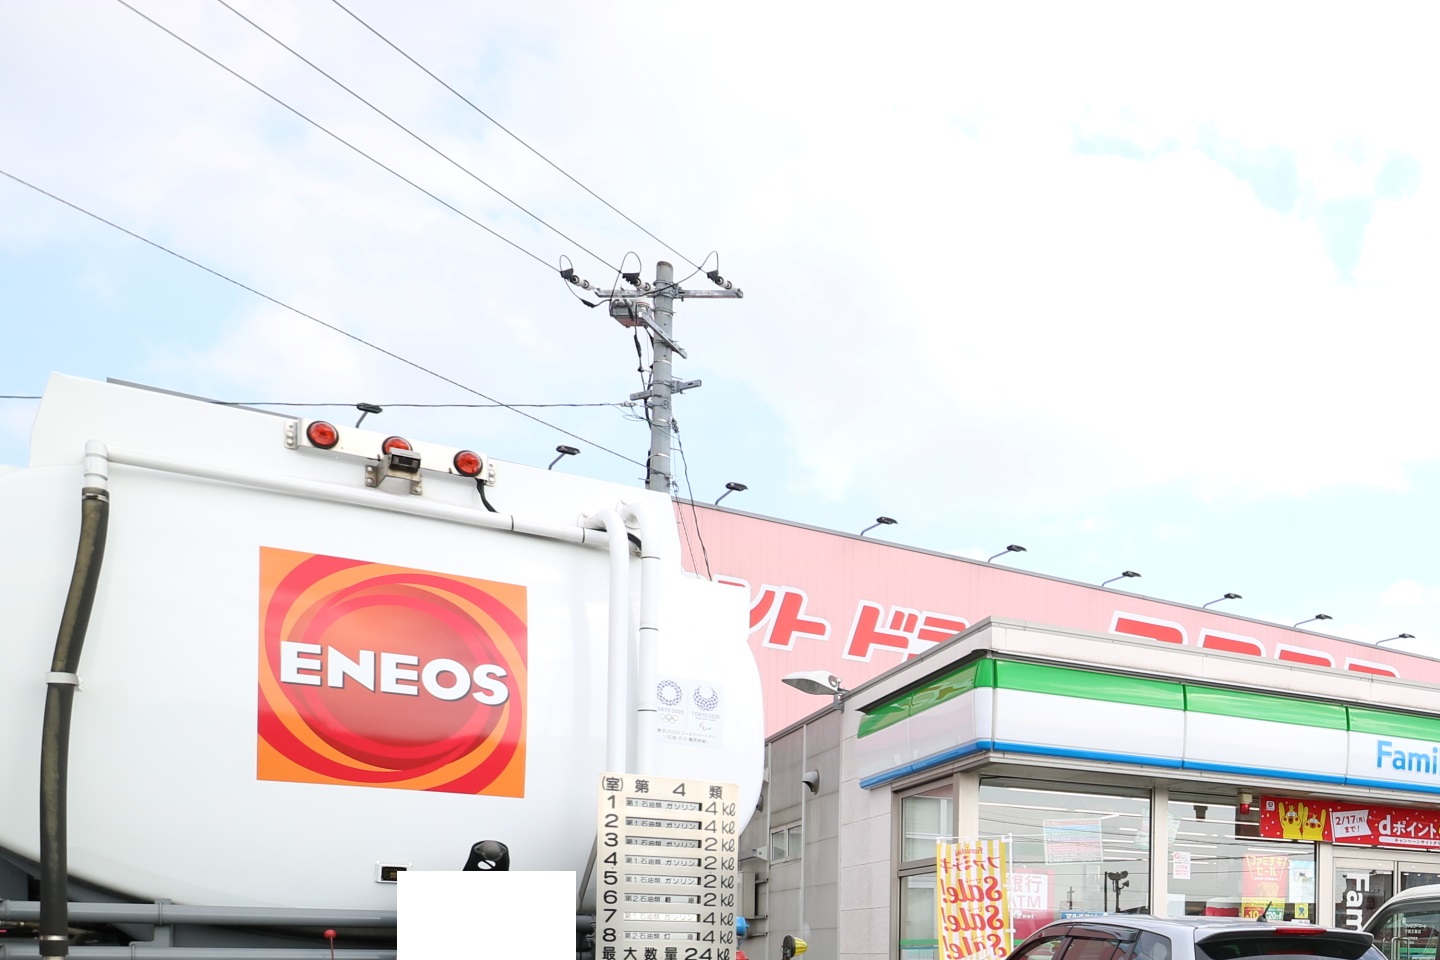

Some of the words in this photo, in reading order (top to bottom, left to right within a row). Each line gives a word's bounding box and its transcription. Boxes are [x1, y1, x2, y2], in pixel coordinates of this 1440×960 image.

[280, 640, 509, 706] ENEOS
[607, 794, 616, 809] 1
[604, 814, 618, 828] 2
[604, 832, 618, 847] 3
[604, 852, 618, 866] 4
[604, 870, 618, 885] 5
[604, 890, 618, 904] 6
[603, 909, 617, 923] 7
[602, 928, 616, 942] 8
[602, 946, 678, 960] 最大数量
